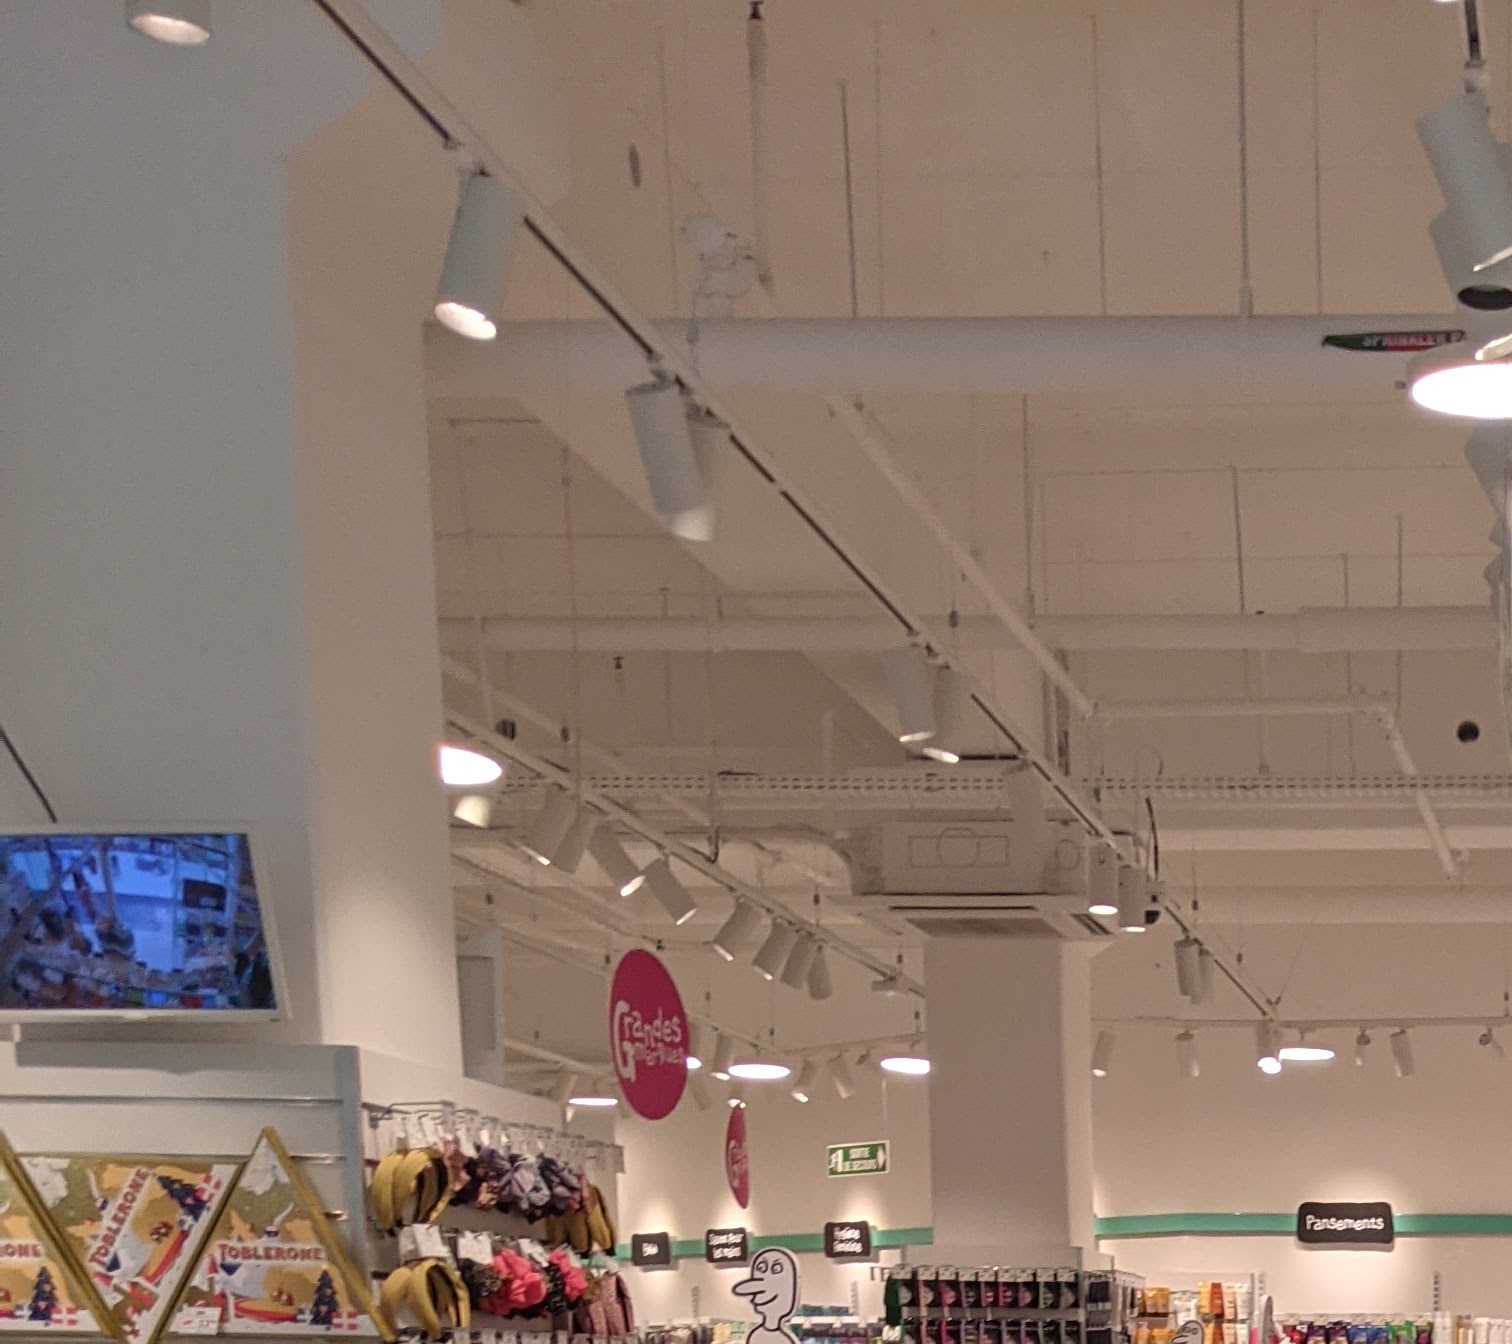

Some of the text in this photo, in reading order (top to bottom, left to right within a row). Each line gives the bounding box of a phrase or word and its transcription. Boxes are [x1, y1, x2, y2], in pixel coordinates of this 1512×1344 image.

[89, 1168, 150, 1264] TOBLERONE
[1306, 1215, 1384, 1231] Pansements
[218, 1243, 324, 1261] TOBLERONE
